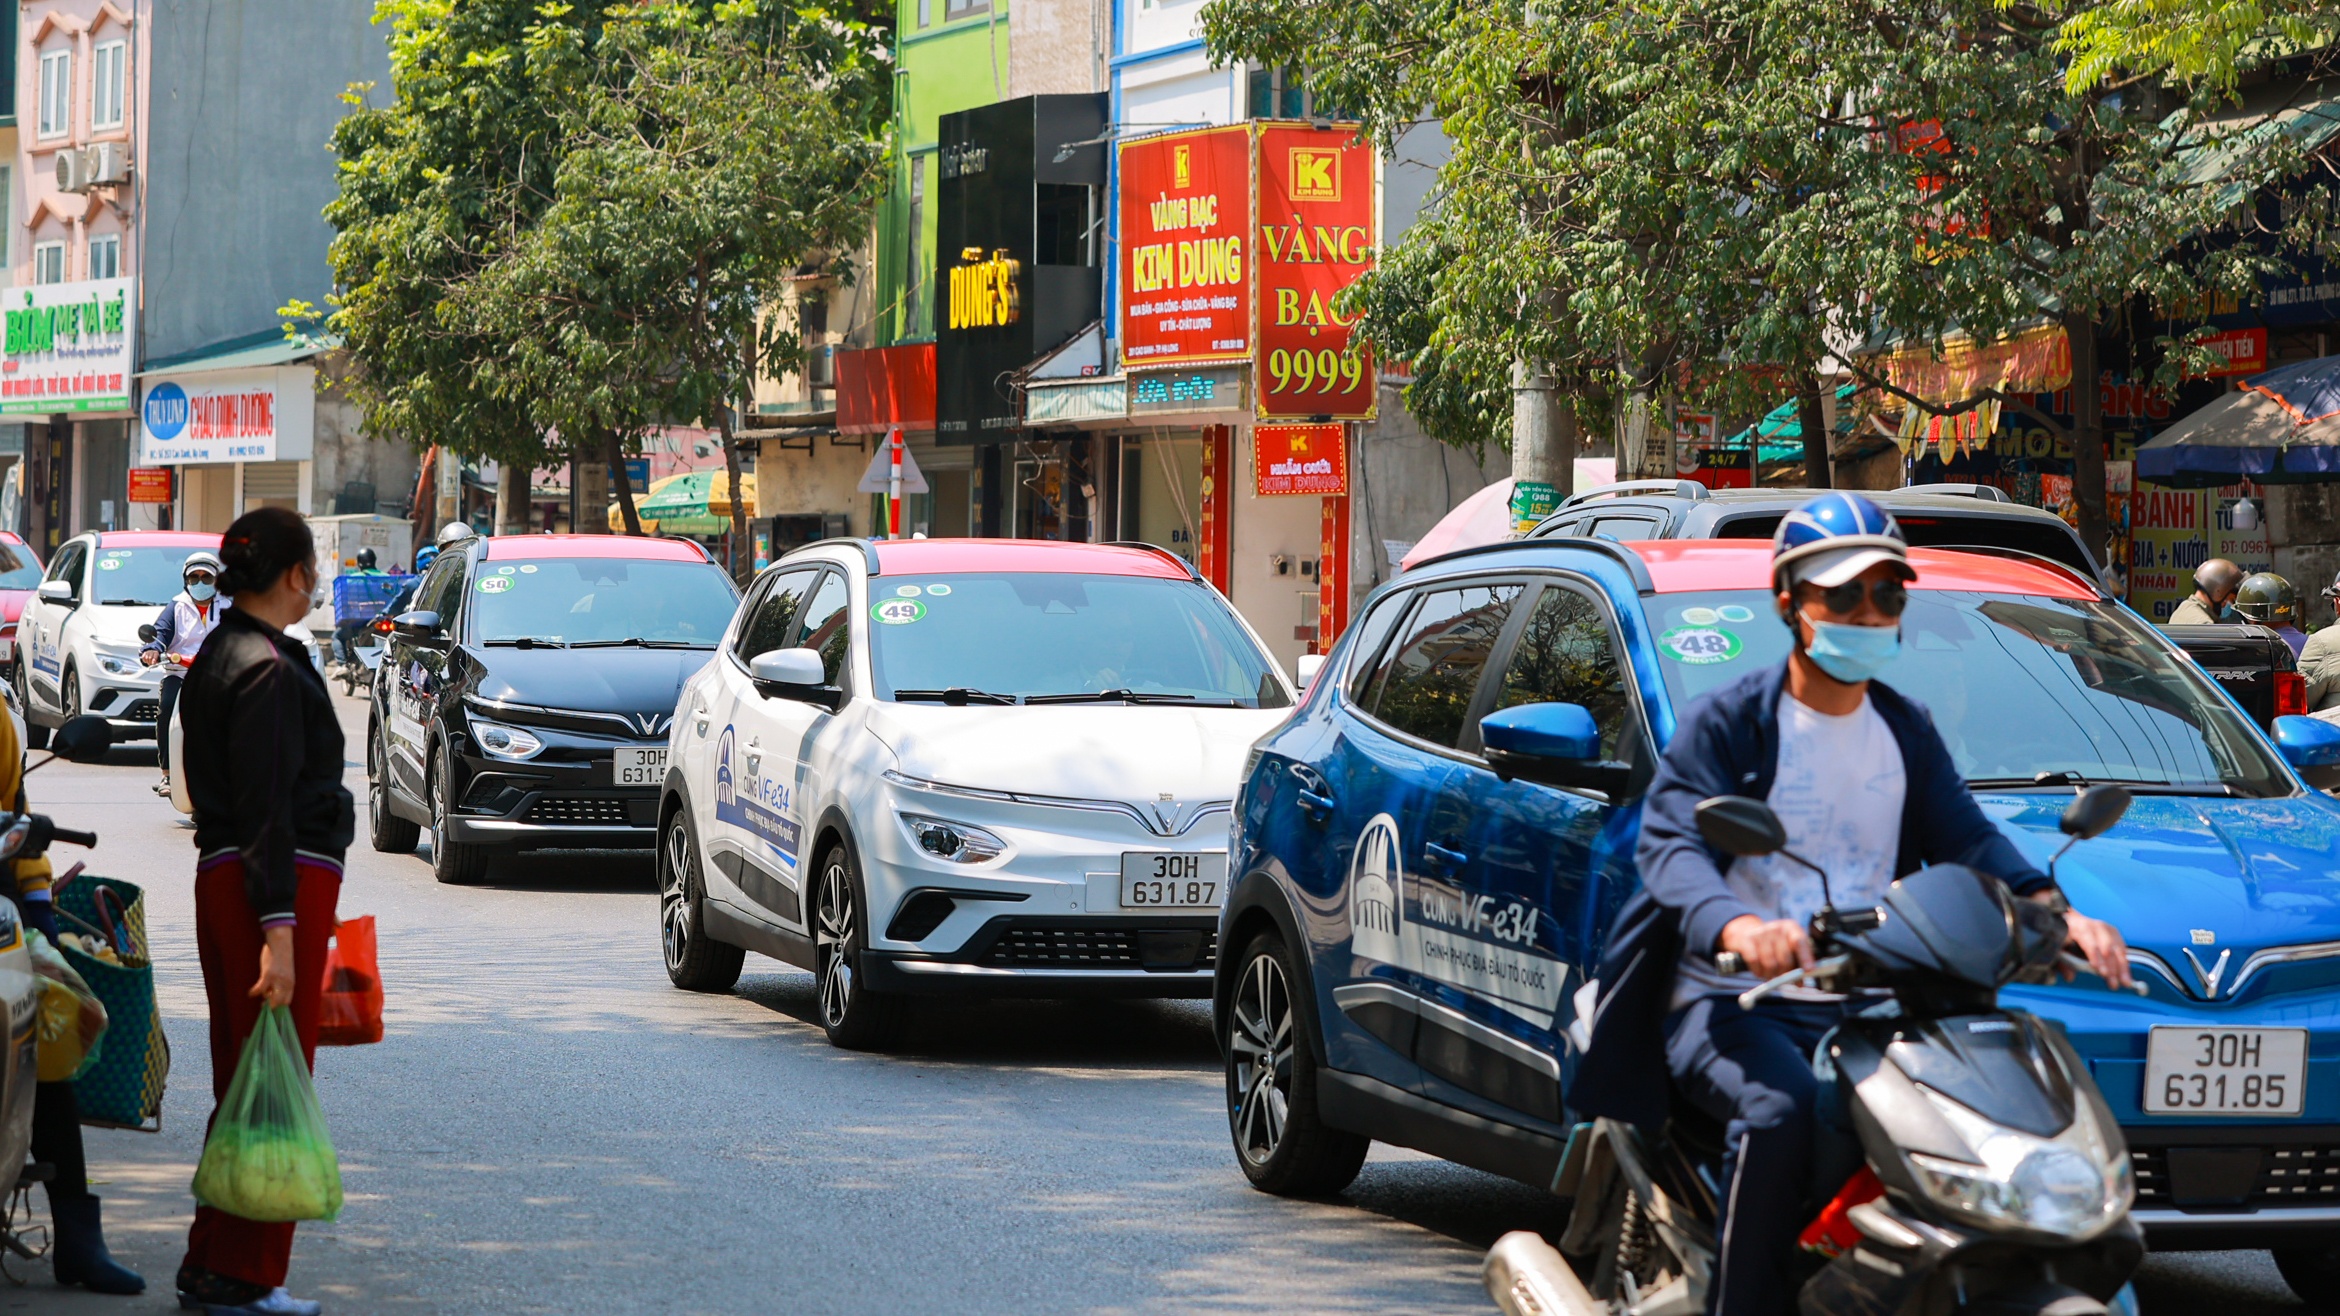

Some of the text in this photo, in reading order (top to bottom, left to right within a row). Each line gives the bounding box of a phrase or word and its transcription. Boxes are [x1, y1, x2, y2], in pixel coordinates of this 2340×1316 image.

[1150, 191, 1217, 234] VÀNG BẠC
[1261, 213, 1368, 264] VÀNG
[1133, 235, 1241, 293] KIM DUNG
[1269, 348, 1362, 394] 9999
[191, 389, 214, 439] CHÁO
[217, 394, 238, 438] DINH
[1708, 453, 1737, 465] 24/7
[1262, 475, 1340, 490] KIM DUNG
[1531, 503, 1541, 514] 15
[2133, 485, 2195, 529] BÁNH
[2133, 541, 2154, 568] BIA
[2221, 541, 2238, 553] ĐT:
[486, 580, 507, 589] 50
[2134, 573, 2176, 592] NHẬN
[884, 605, 916, 617] 49
[1680, 635, 1727, 654] 48
[637, 750, 667, 765] 30H
[1153, 856, 1198, 878] 30H
[1133, 881, 1216, 904] 631.87
[1451, 947, 1472, 972] PHỤC
[1473, 954, 1488, 977] ĐỊA
[1521, 965, 1546, 990] QUỐC
[2195, 1034, 2262, 1069] 30H
[2164, 1074, 2285, 1109] 631.85
